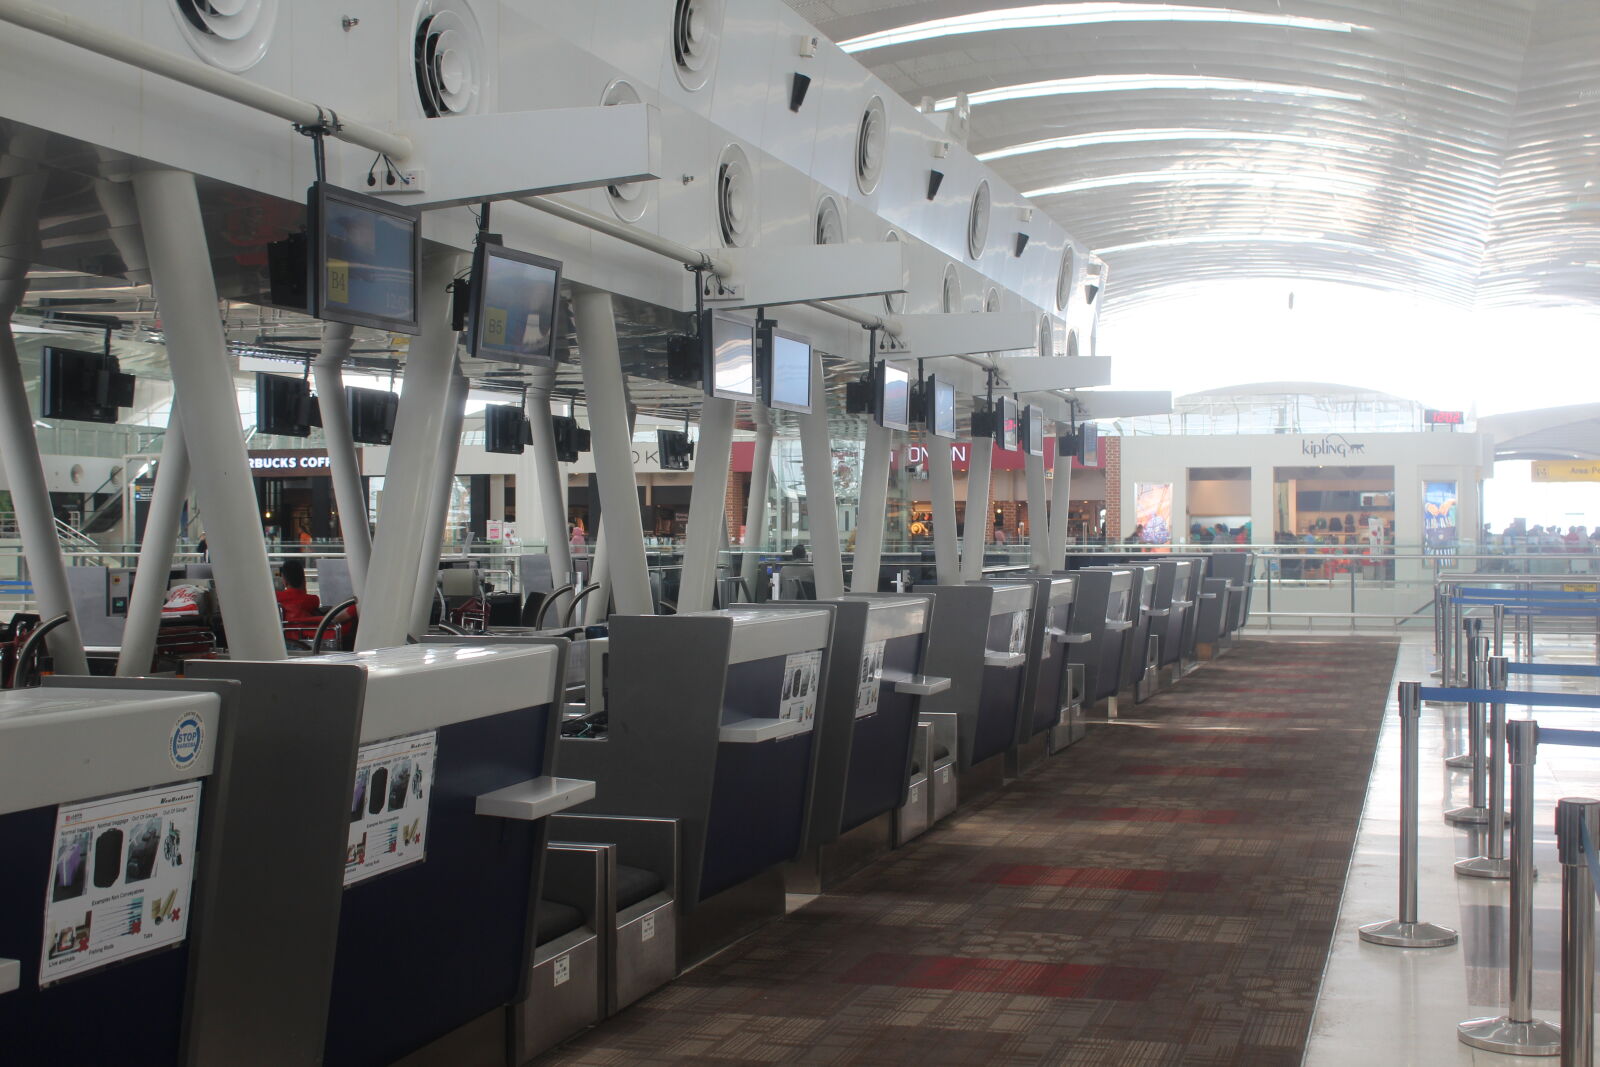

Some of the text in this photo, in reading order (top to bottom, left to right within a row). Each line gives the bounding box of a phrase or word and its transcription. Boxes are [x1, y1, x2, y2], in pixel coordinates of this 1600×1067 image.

[331, 271, 345, 291] B4
[488, 318, 503, 335] B5
[1302, 438, 1347, 458] kipling
[177, 732, 197, 744] STOP
